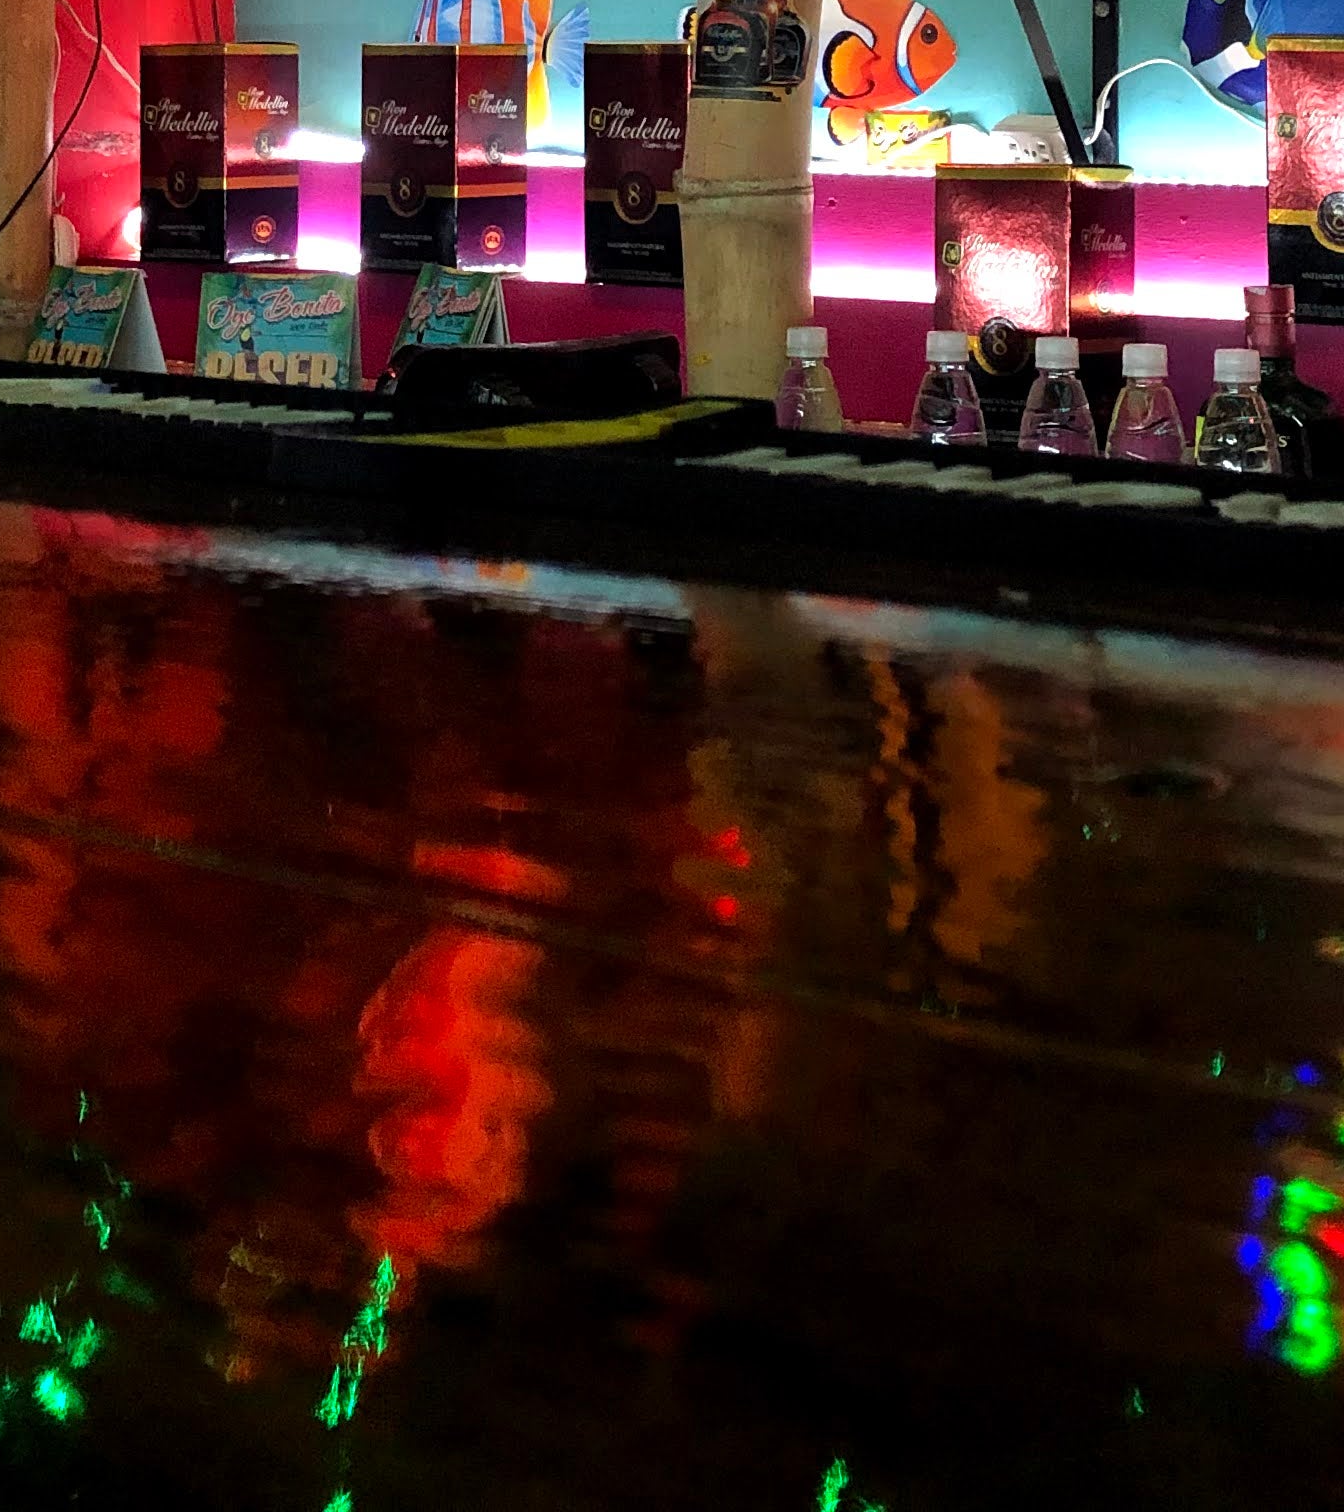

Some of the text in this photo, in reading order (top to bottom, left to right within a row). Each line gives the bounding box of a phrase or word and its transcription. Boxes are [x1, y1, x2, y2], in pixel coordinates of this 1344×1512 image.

[158, 97, 181, 112] Ron
[382, 99, 407, 115] Ron
[606, 101, 635, 117] Ron
[175, 170, 186, 193] 8
[399, 176, 411, 200] 8
[627, 183, 641, 207] 8
[257, 285, 346, 323] Bonita
[992, 328, 1007, 355] 8
